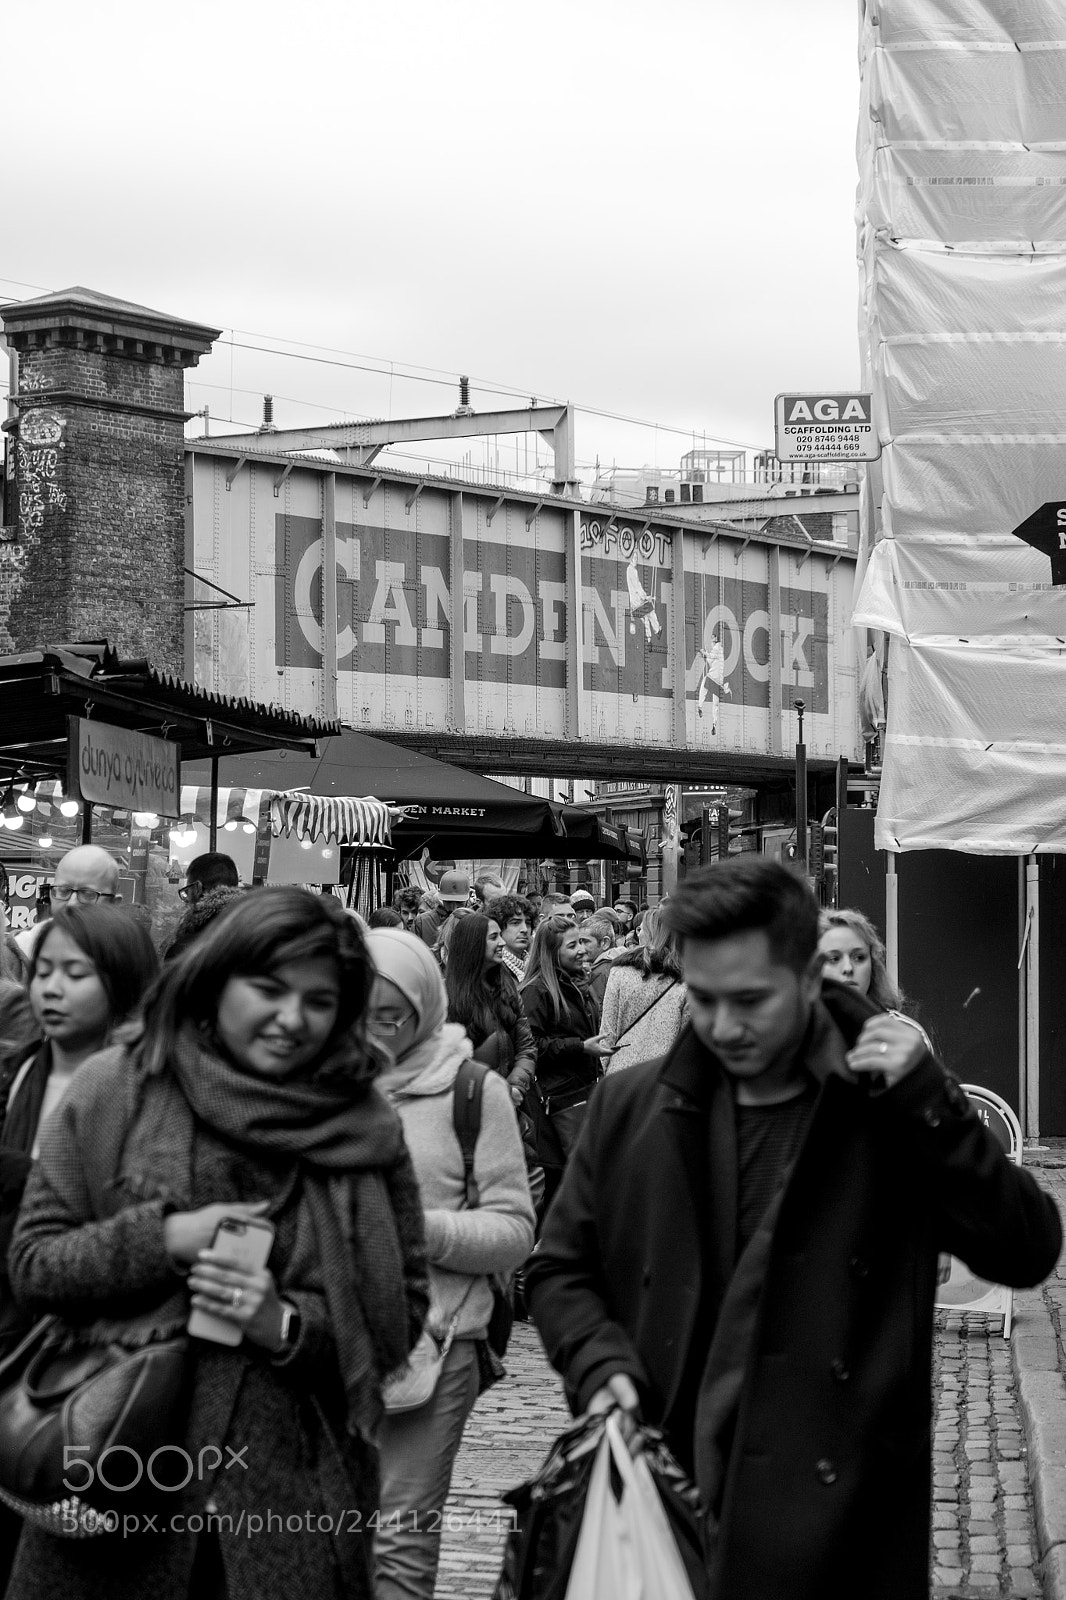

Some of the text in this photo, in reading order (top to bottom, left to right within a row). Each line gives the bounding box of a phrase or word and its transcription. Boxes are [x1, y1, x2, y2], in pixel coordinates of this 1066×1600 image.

[788, 399, 867, 421] AGA
[784, 425, 871, 434] SCAFFOLDING LTD
[796, 435, 813, 443] 020
[295, 537, 815, 692] CAMDEN LOCK
[82, 734, 121, 791] dunya
[432, 806, 486, 817] MARKET
